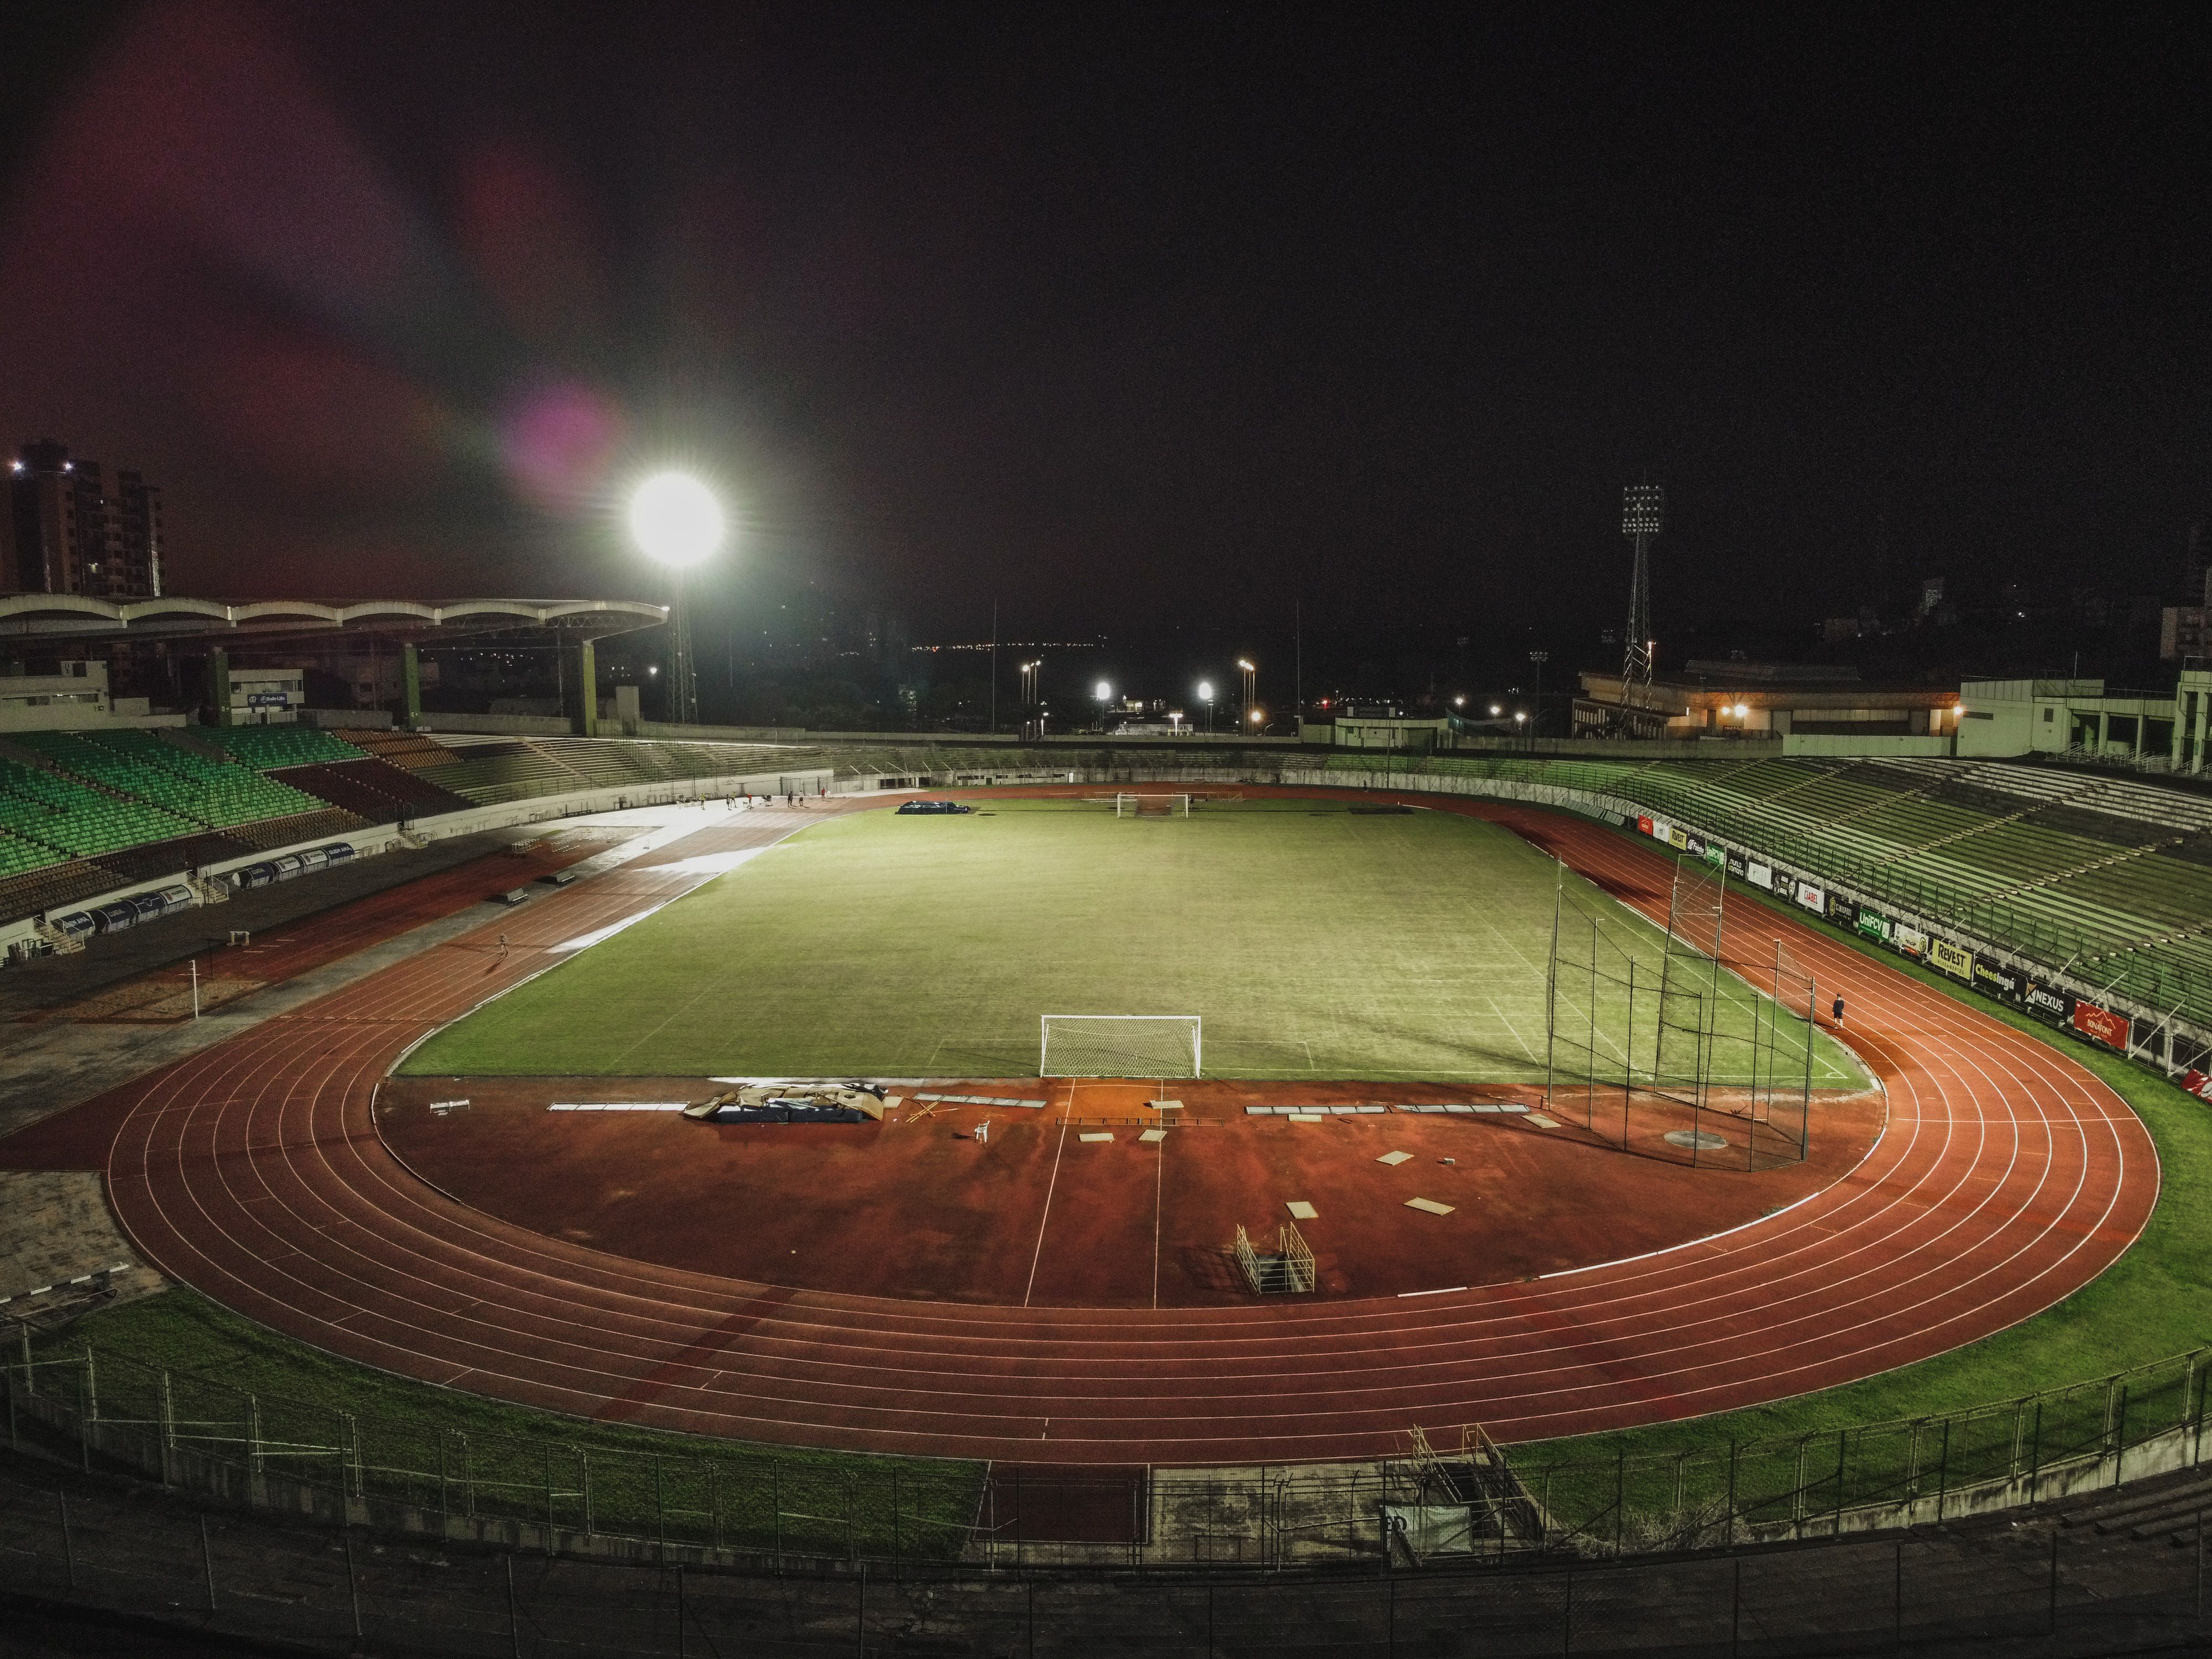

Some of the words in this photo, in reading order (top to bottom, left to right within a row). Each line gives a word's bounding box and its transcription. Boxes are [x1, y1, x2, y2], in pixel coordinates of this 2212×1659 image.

[1860, 912, 1882, 931] UniFCV
[1938, 943, 1965, 968] REVEST
[2035, 991, 2064, 1013] NEXUS
